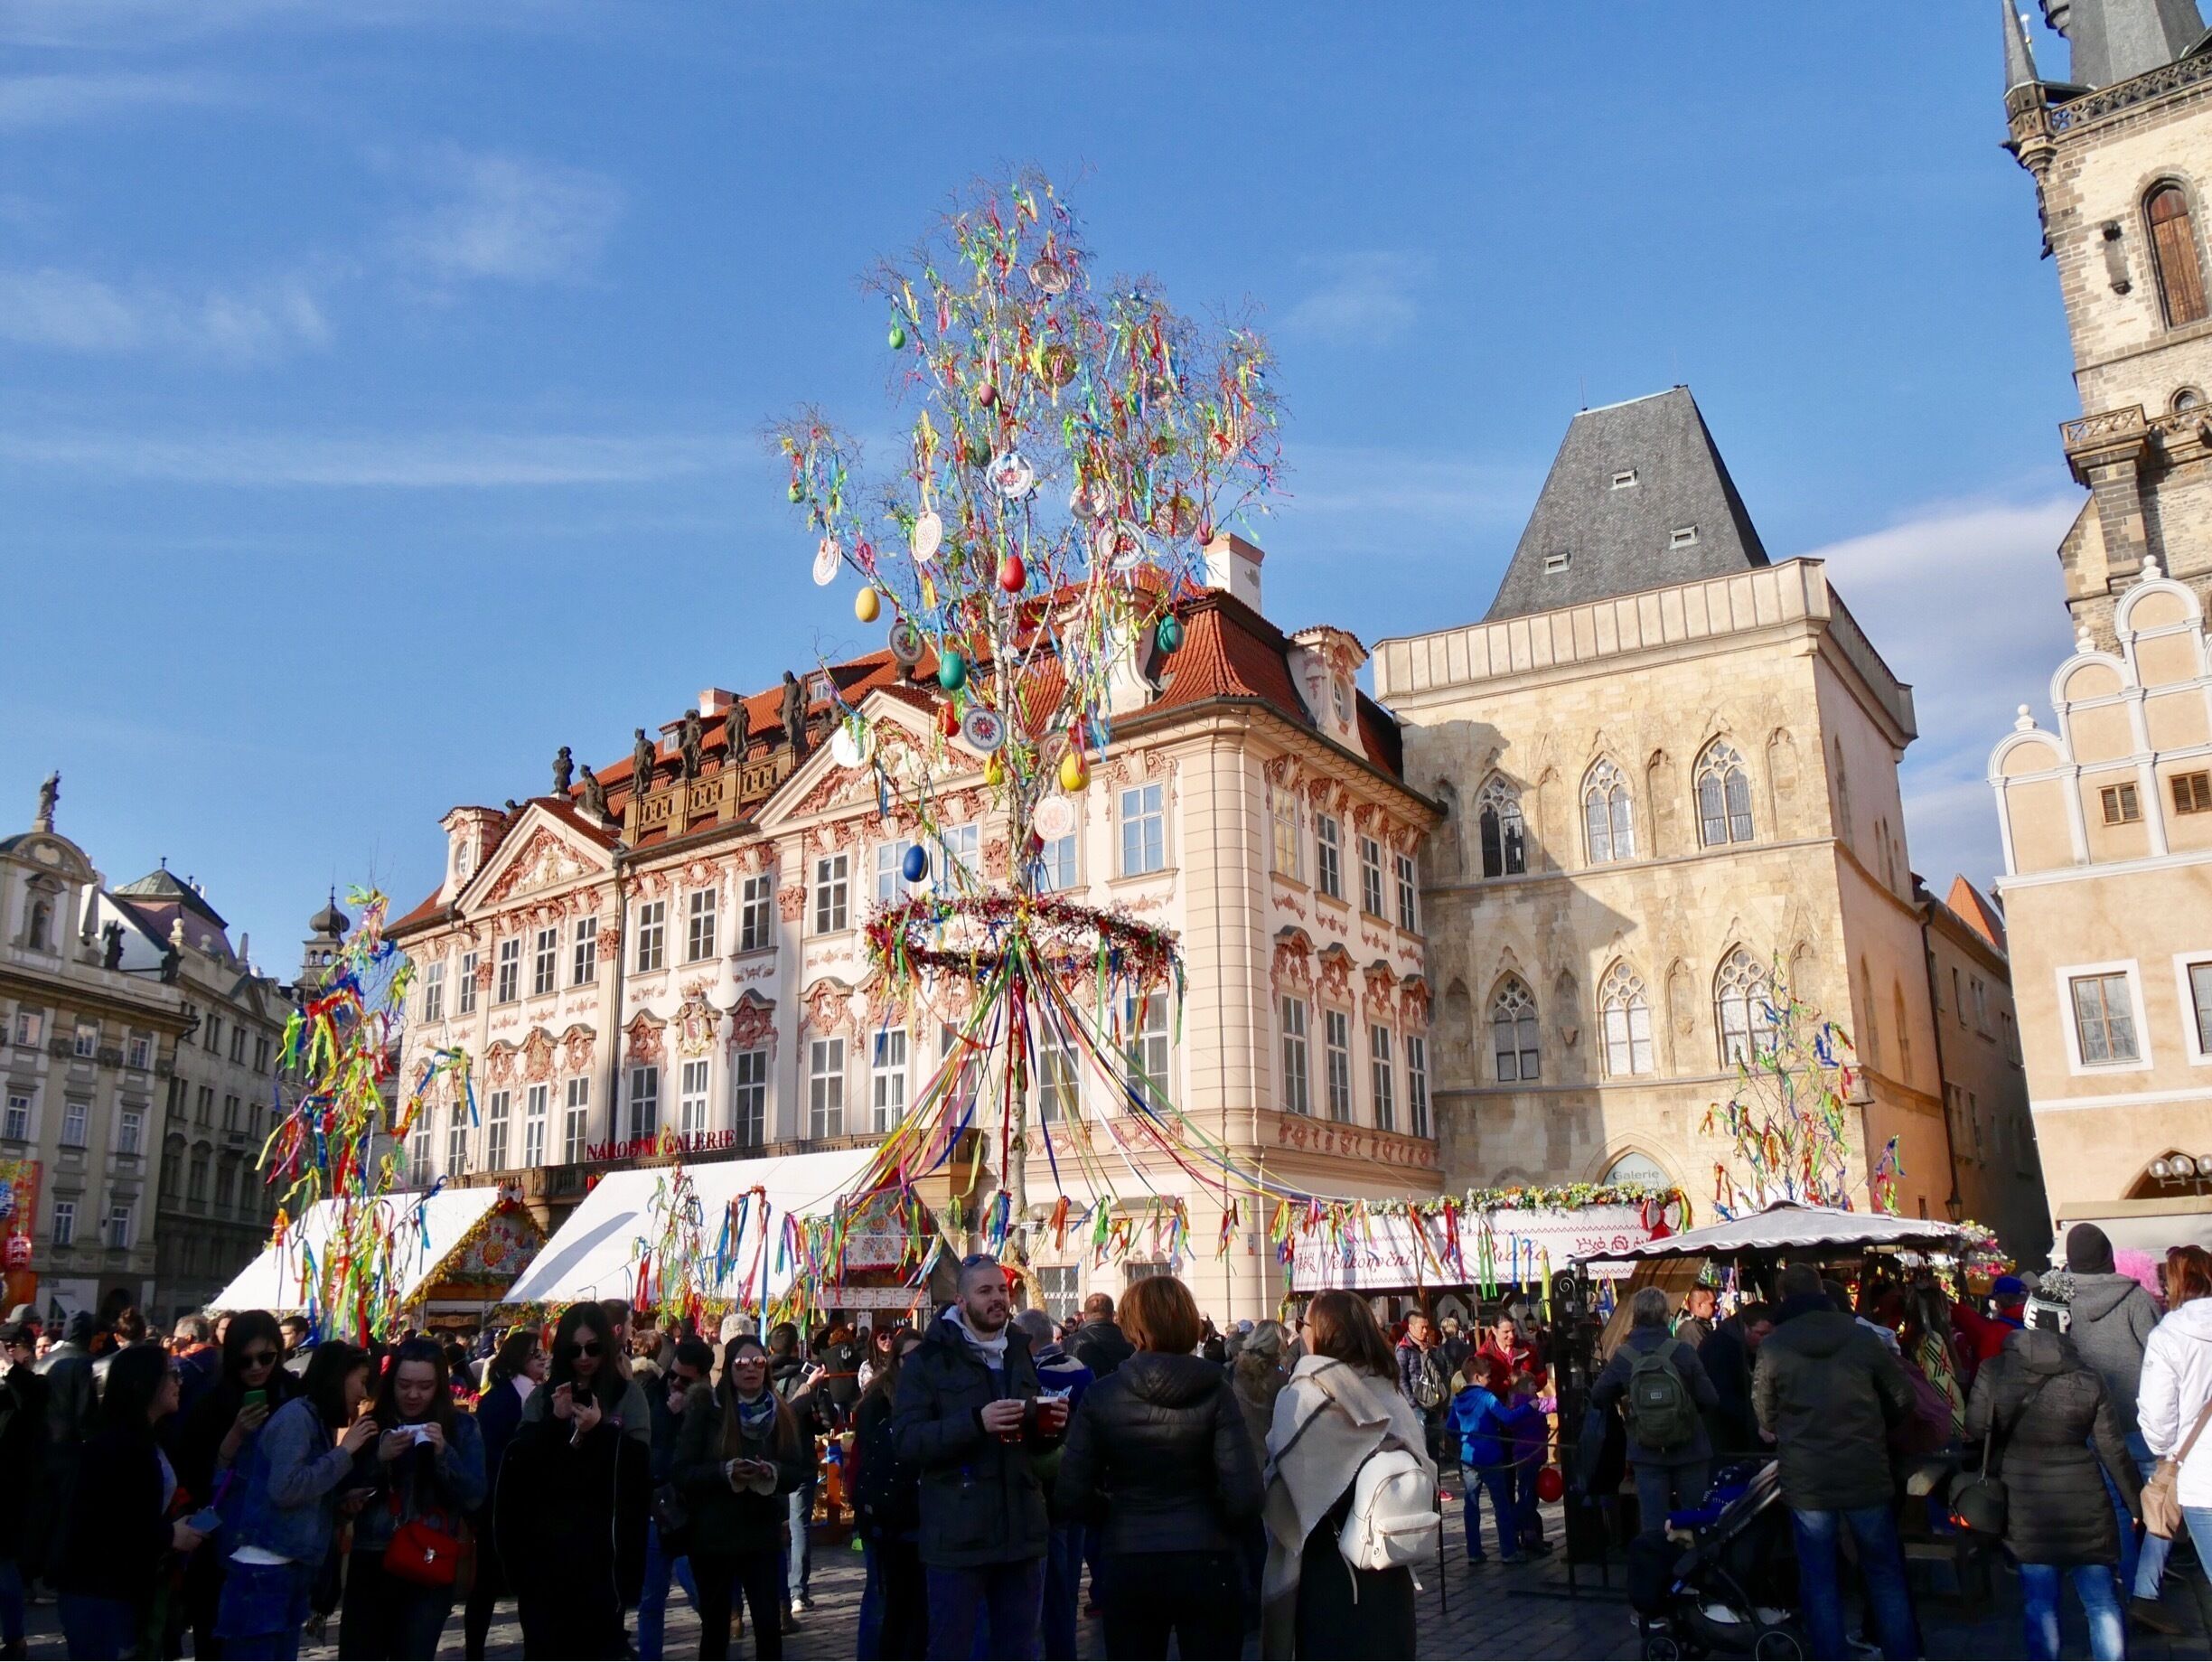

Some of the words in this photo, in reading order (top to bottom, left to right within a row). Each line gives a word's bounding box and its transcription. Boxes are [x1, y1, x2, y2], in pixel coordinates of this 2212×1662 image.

[586, 1133, 658, 1160] NÁRODNÍ
[664, 1130, 736, 1155] GALERIE
[1613, 1170, 1660, 1180] Galerie
